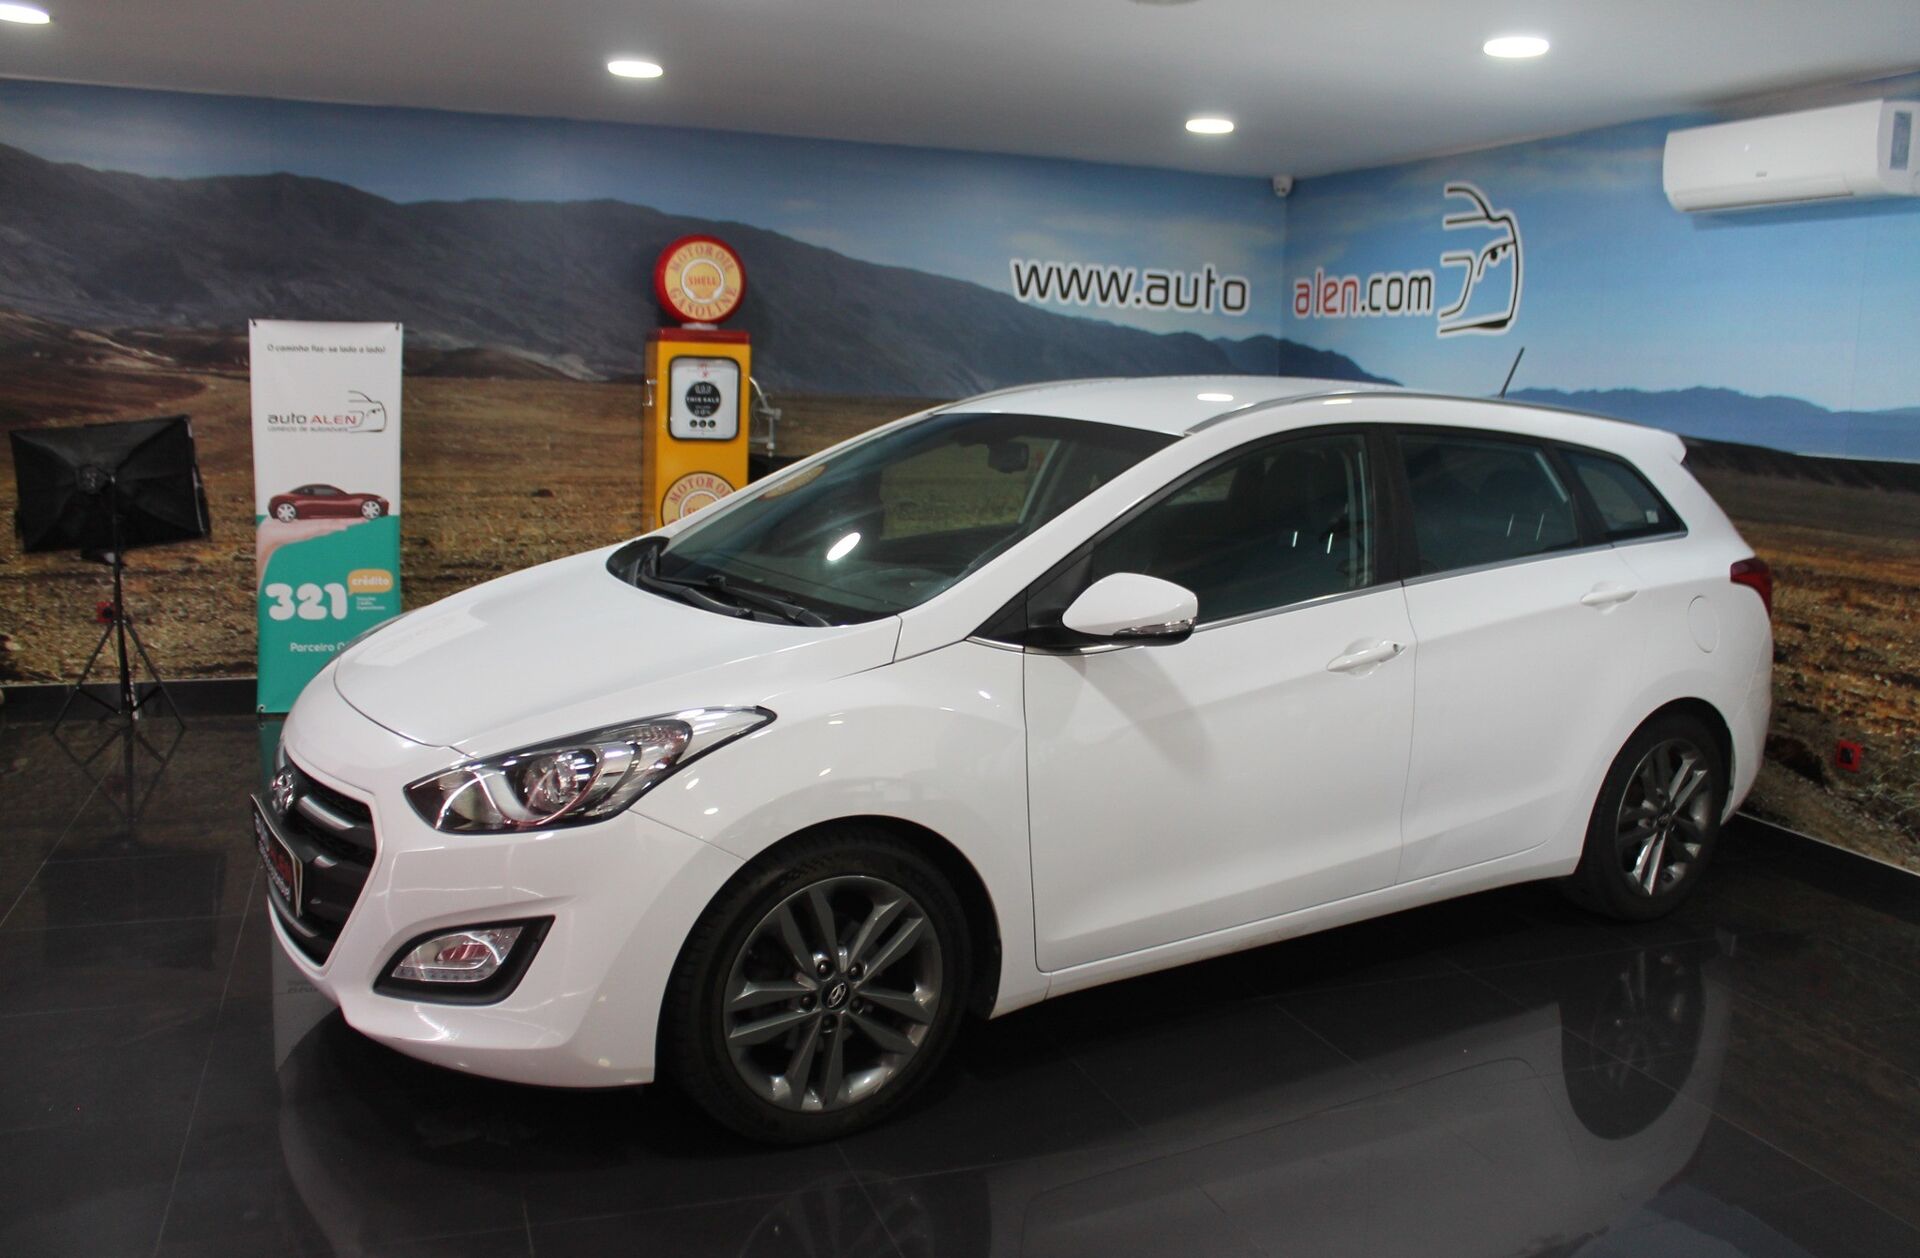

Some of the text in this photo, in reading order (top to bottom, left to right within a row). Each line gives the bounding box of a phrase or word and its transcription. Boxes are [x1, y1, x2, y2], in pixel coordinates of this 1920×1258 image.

[669, 244, 735, 273] MOTOR OIL
[686, 275, 718, 286] SHELL
[1012, 262, 1433, 315] www.auto alen.com
[669, 286, 738, 318] GASOLINE
[267, 344, 274, 352] O
[275, 343, 309, 353] caminho
[267, 412, 357, 424] auto ALEN
[669, 476, 714, 504] MOTOR
[265, 583, 348, 620] 321
[289, 642, 335, 652] Parceiro
